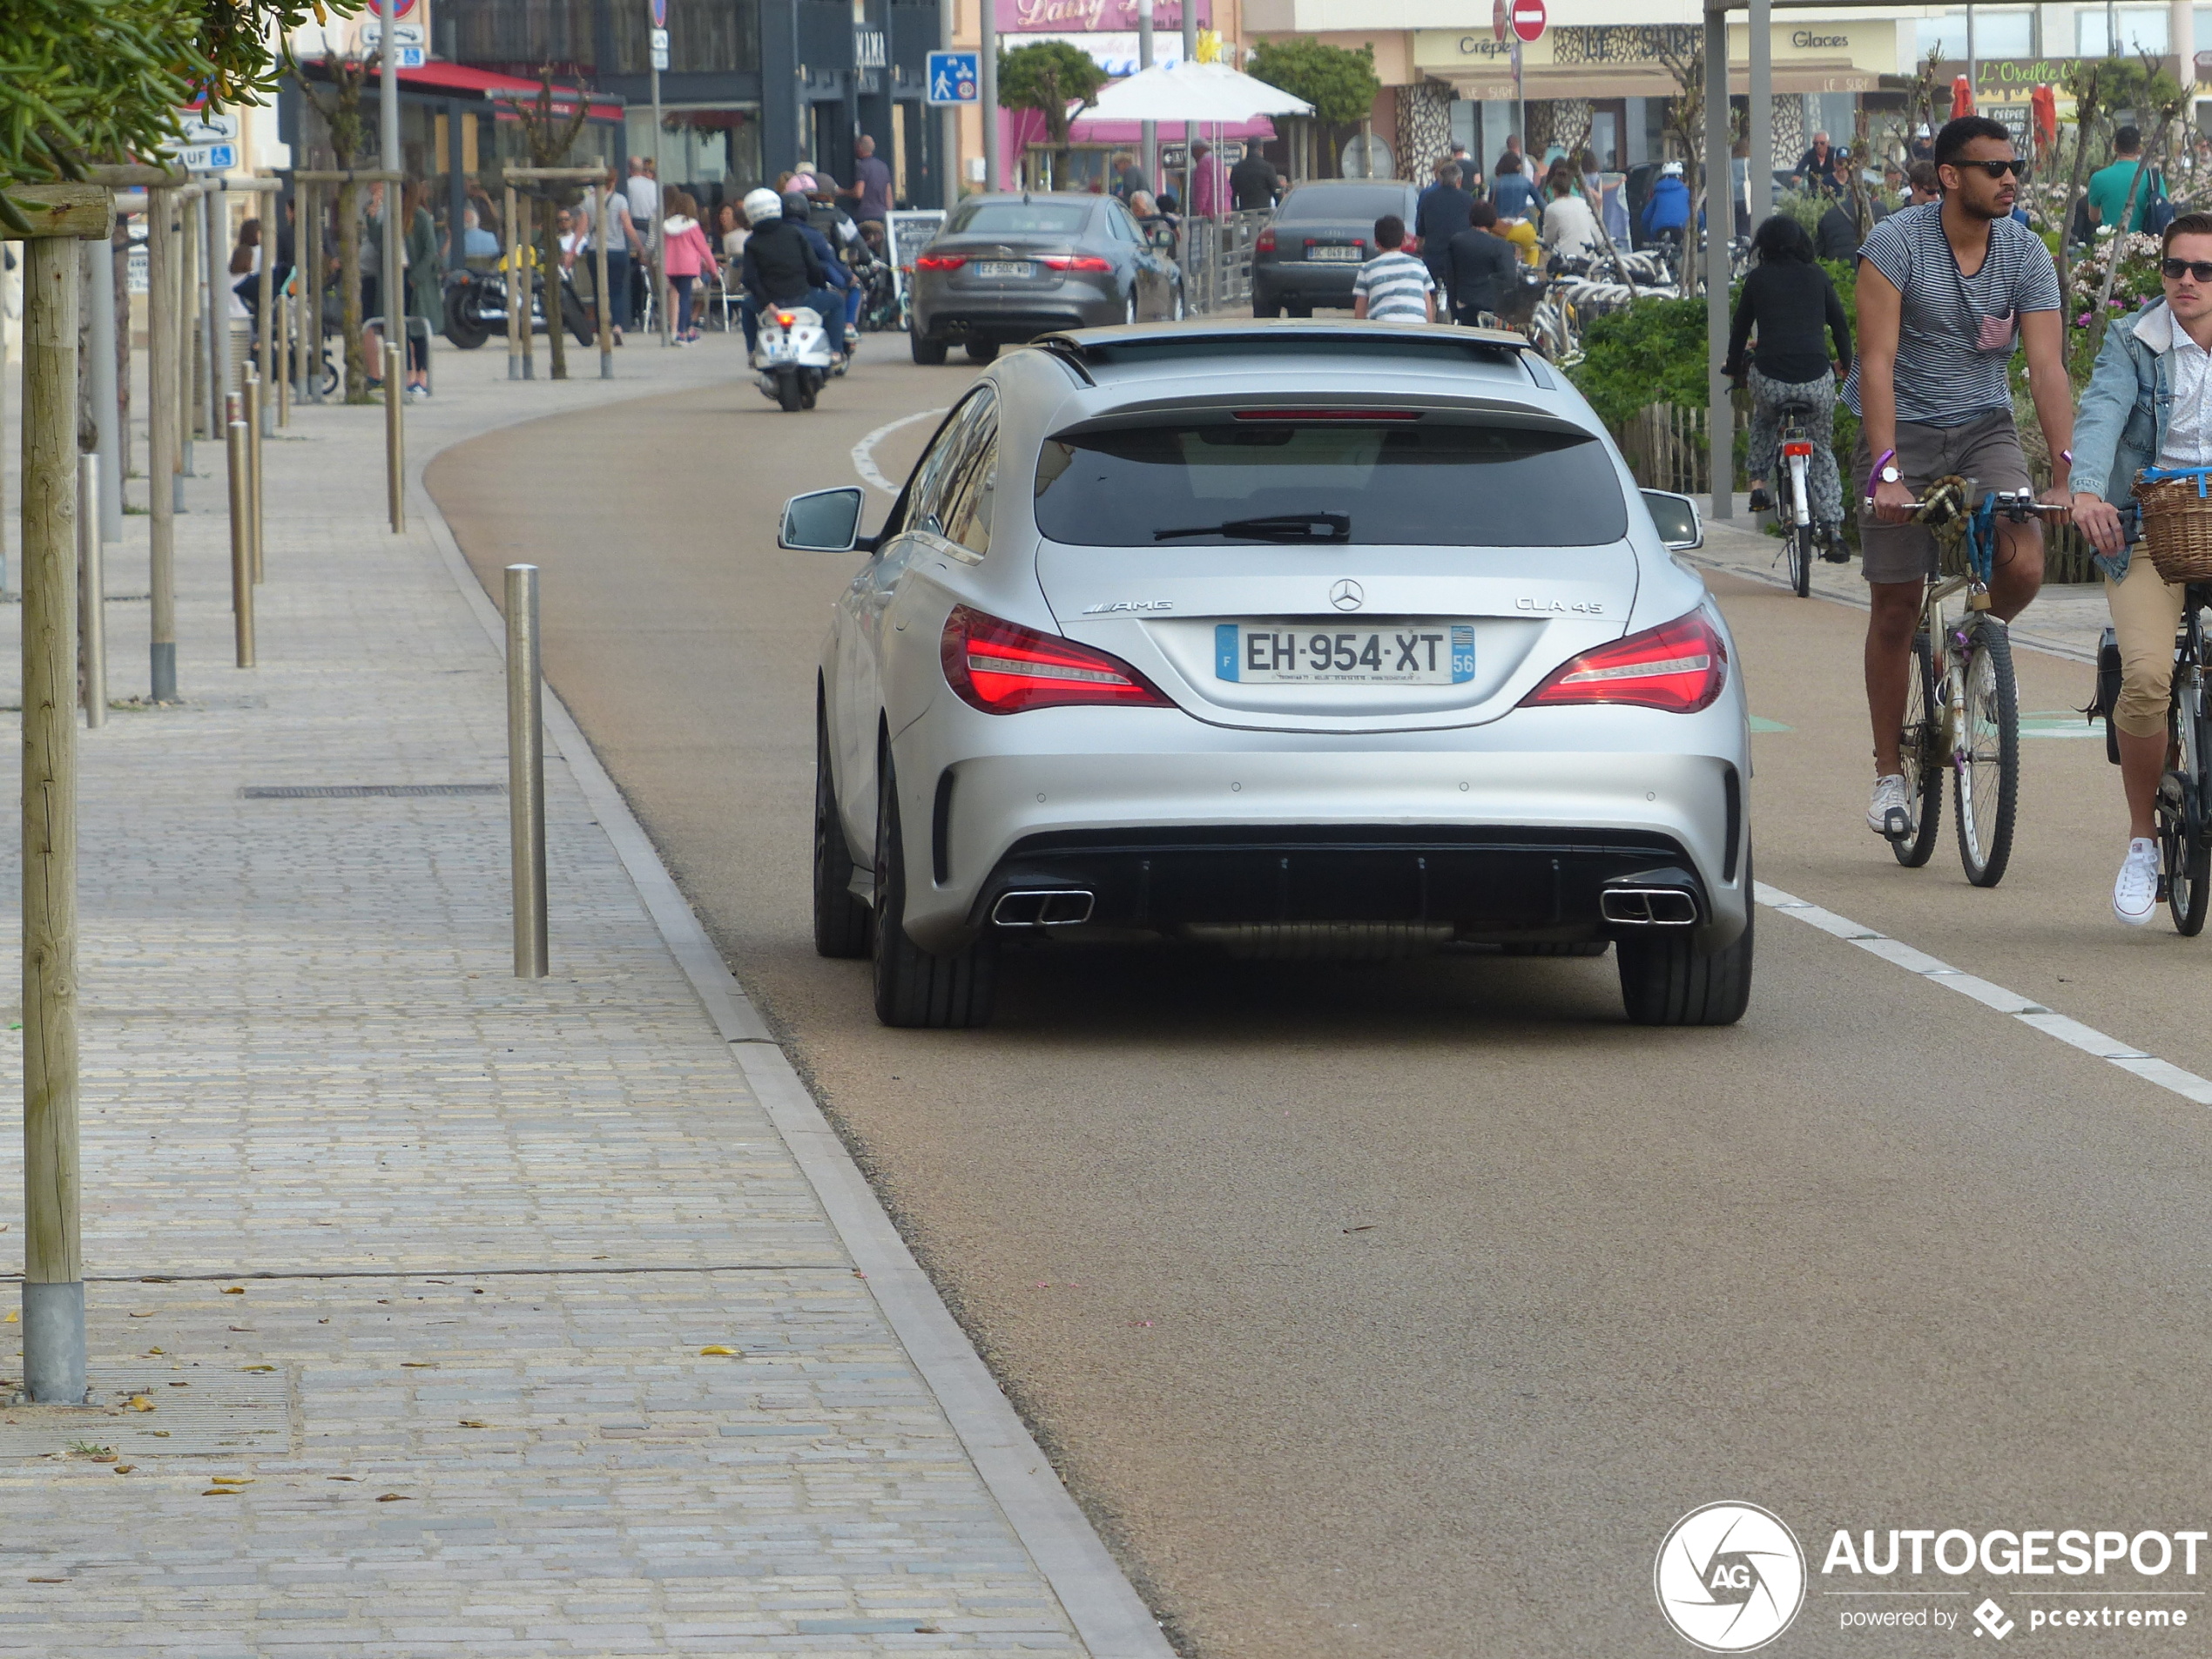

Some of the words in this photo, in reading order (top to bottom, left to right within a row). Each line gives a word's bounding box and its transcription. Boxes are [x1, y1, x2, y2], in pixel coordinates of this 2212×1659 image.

[1792, 30, 1849, 47] Glaces
[856, 31, 887, 67] MAMA
[1460, 37, 1514, 59] Crêpe
[1979, 61, 2059, 84] L'Oreille
[961, 84, 972, 94] 20
[1110, 600, 1173, 612] AMG
[1516, 597, 1566, 611] CLA
[1571, 601, 1604, 614] 45
[1247, 633, 1444, 671] EH-954-XT
[1224, 656, 1231, 667] F
[1453, 655, 1474, 673] 56
